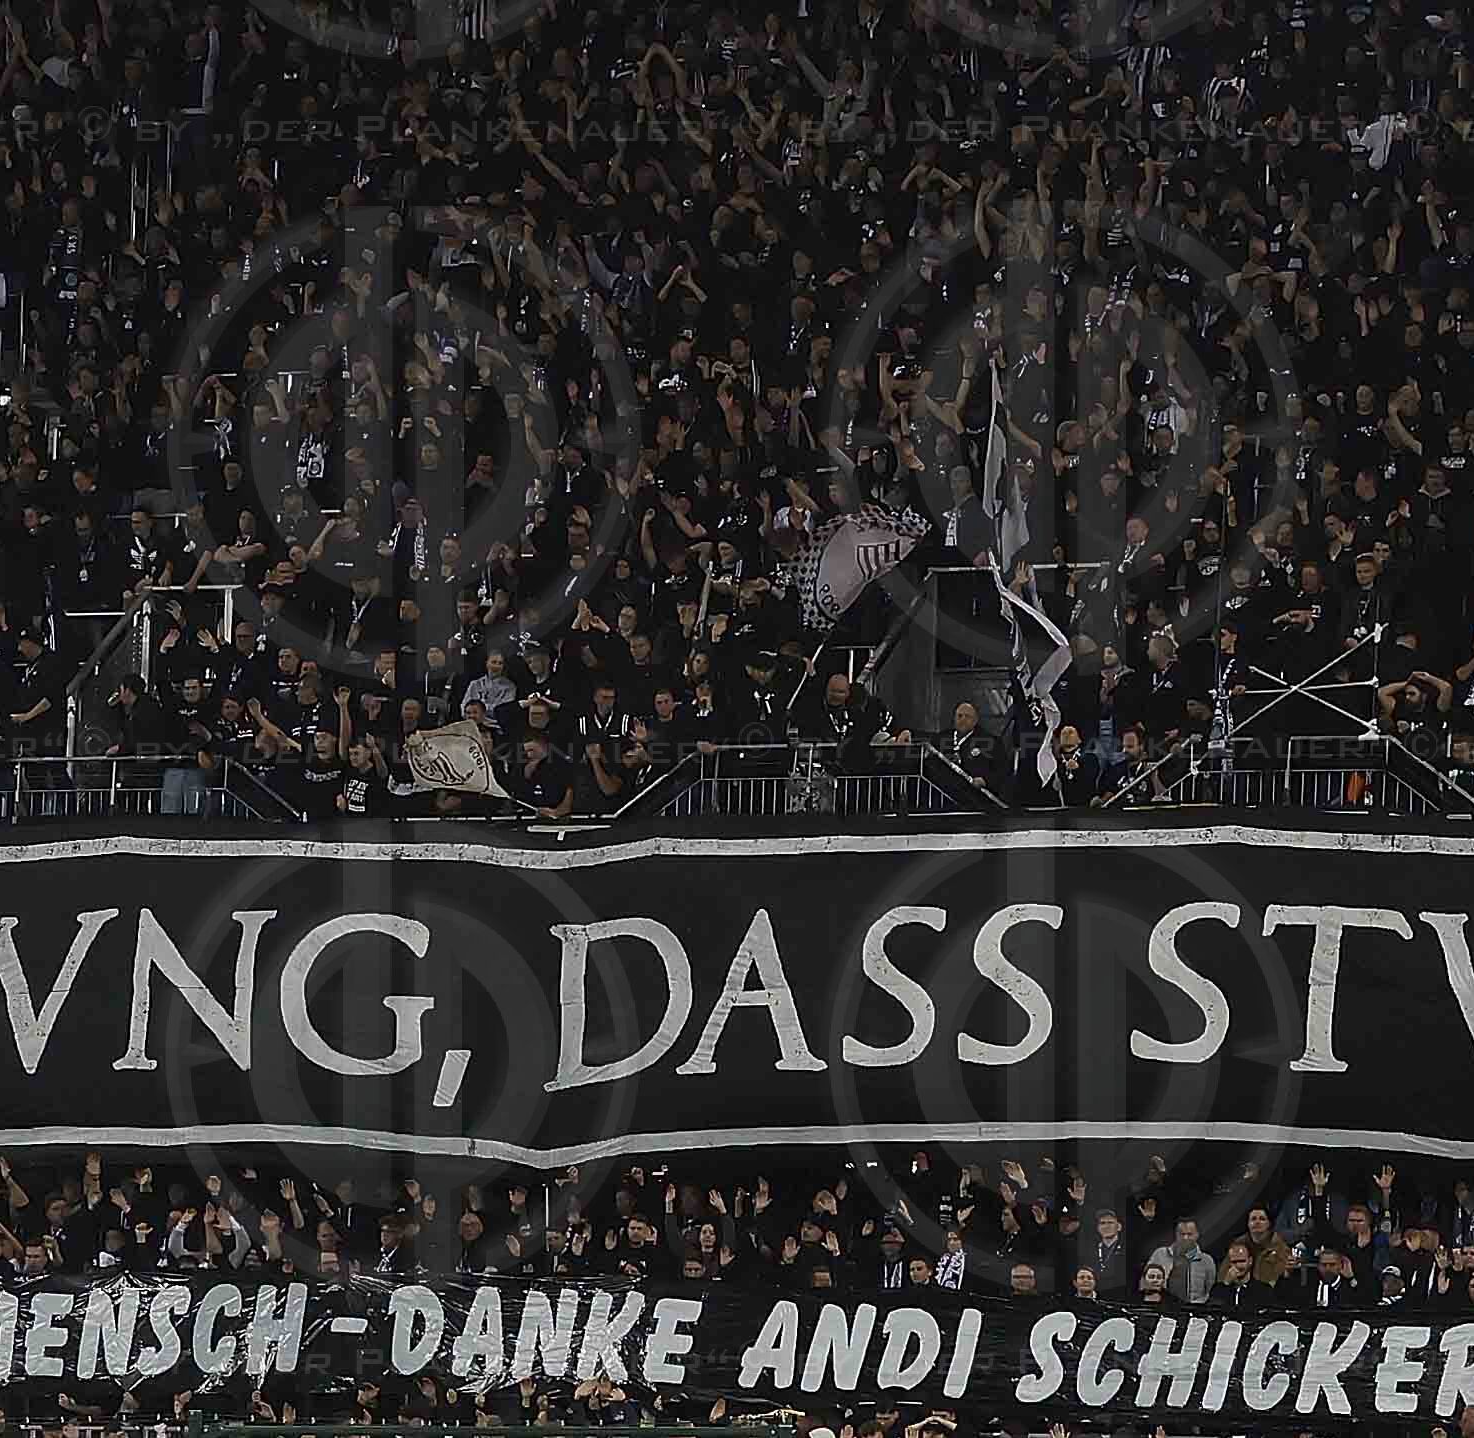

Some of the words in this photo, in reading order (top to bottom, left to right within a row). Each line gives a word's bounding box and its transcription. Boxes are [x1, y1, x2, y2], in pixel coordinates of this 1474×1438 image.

[543, 904, 1064, 1092] DASS
[388, 1285, 703, 1386] DANKE
[740, 1299, 983, 1398] ANDI
